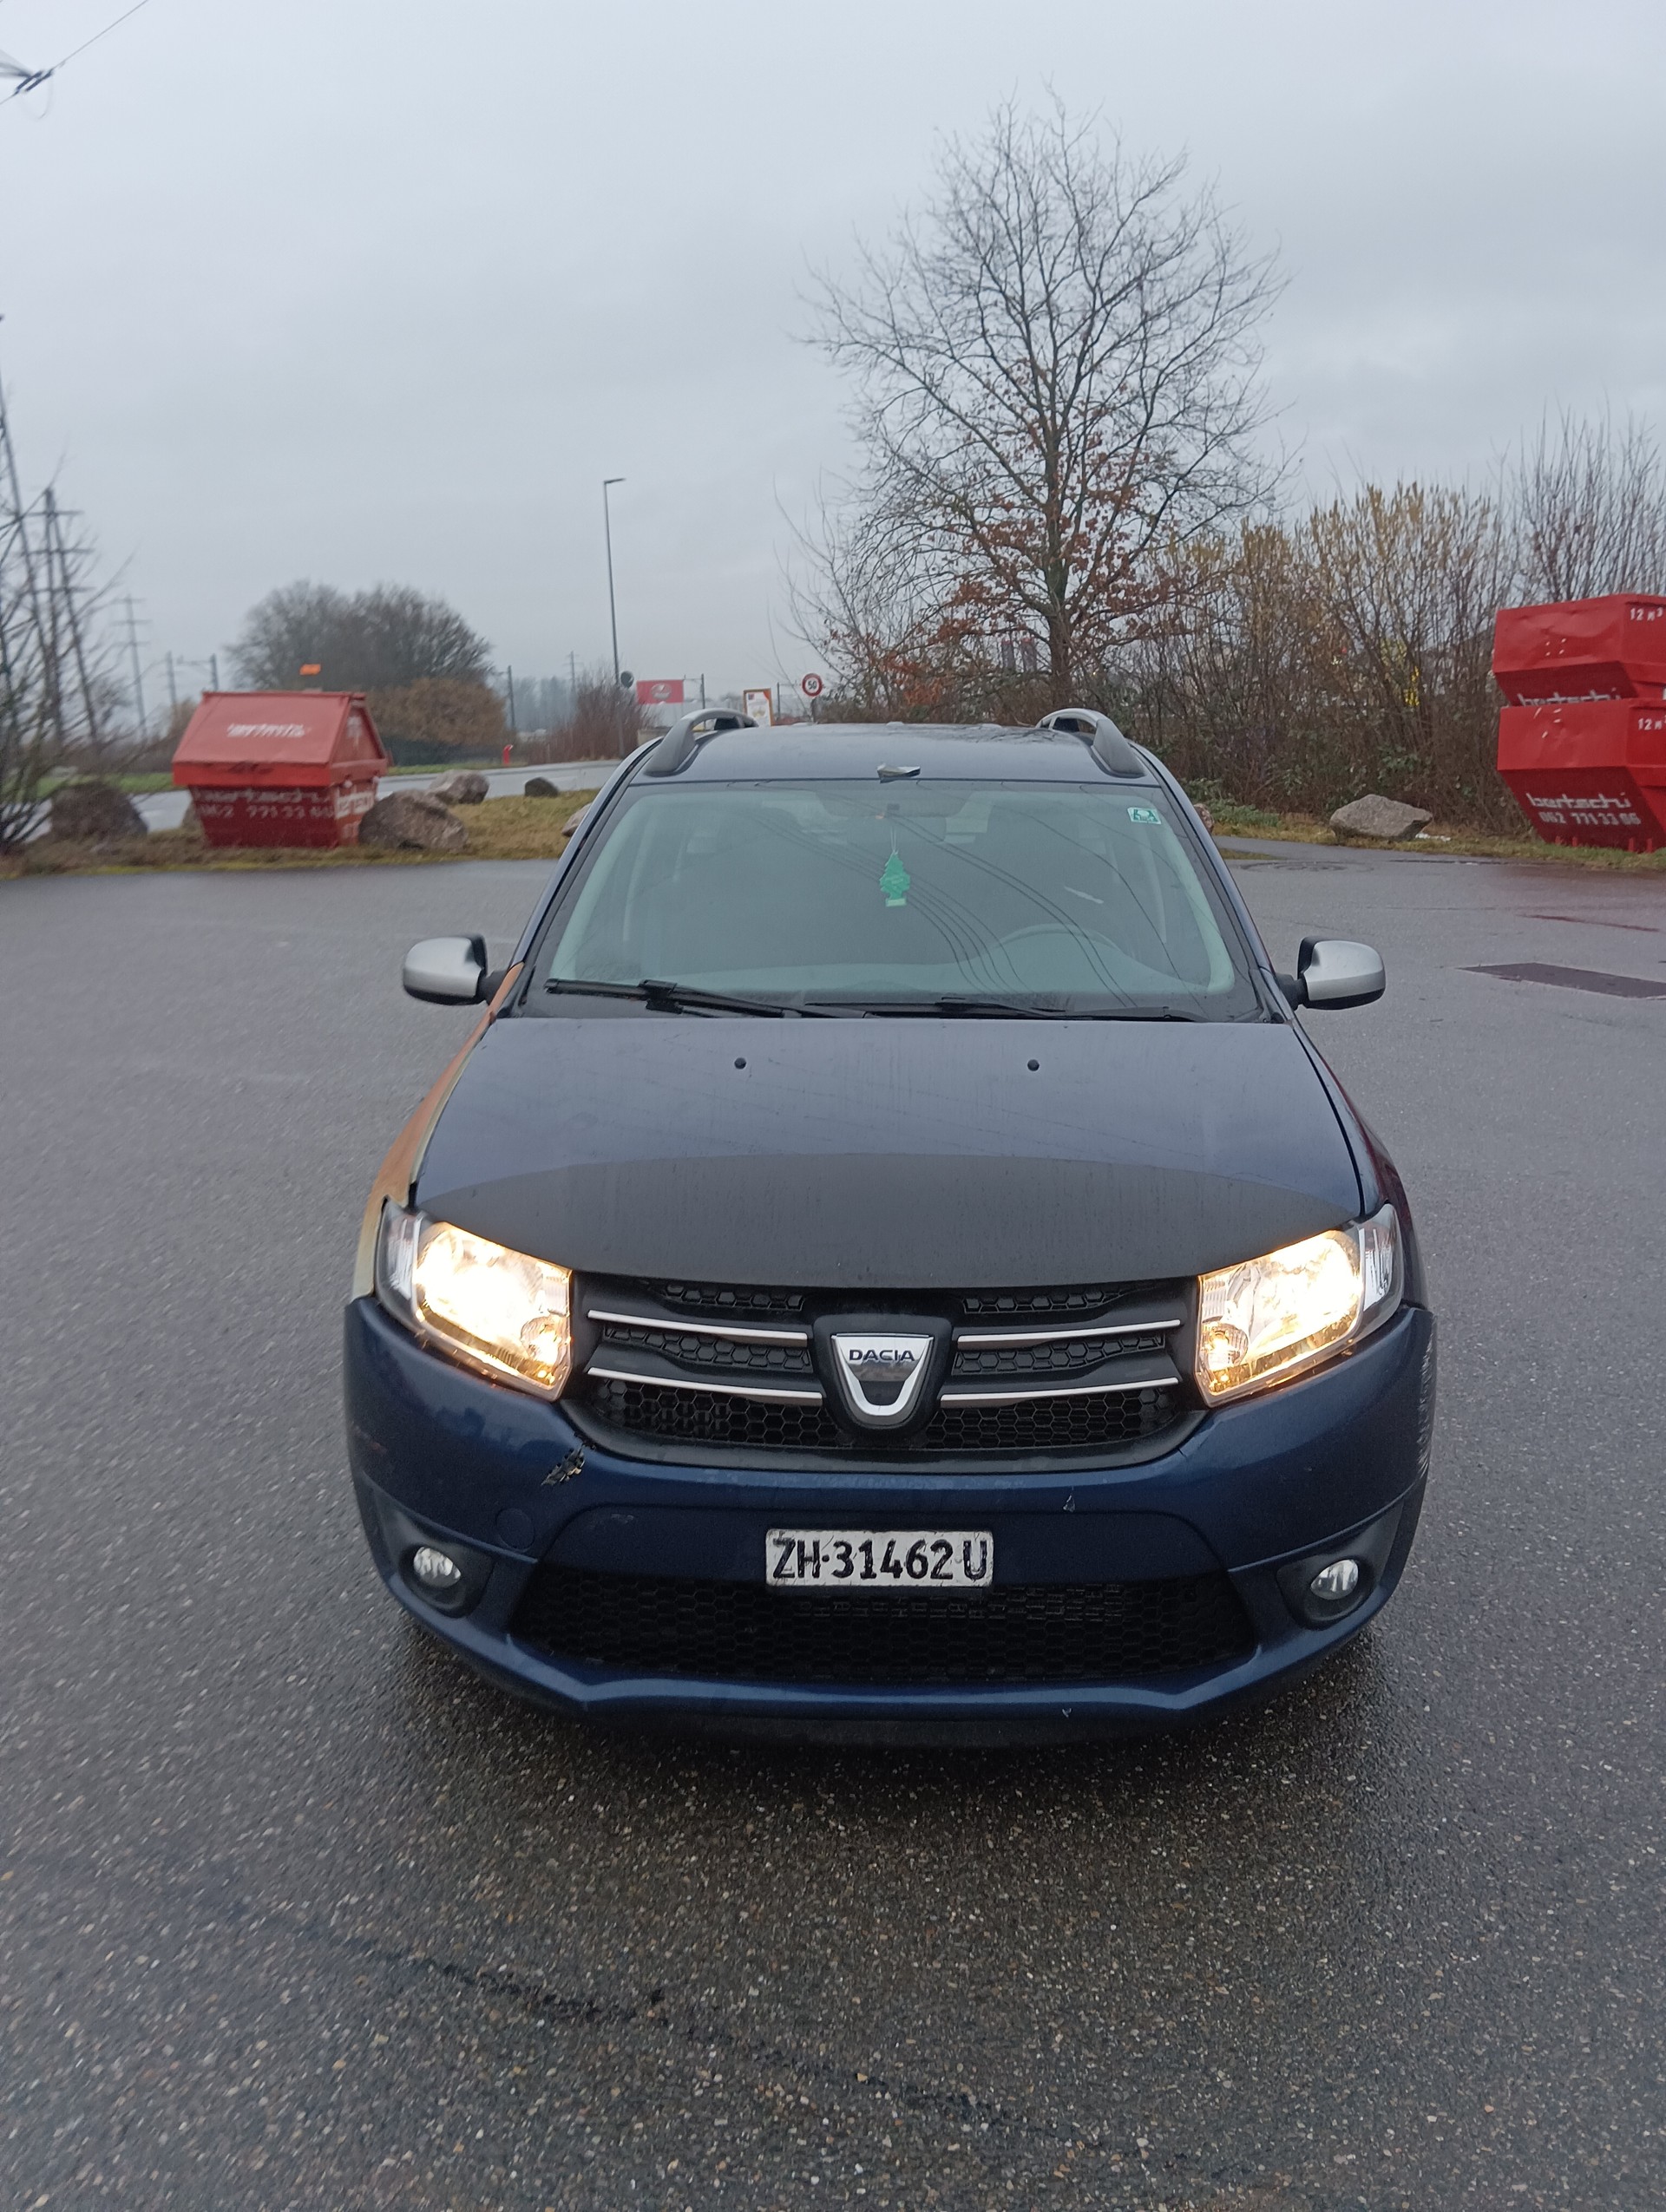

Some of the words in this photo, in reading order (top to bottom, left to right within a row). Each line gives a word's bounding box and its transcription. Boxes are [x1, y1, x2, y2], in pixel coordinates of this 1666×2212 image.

[1630, 607, 1644, 621] 12
[808, 680, 817, 690] 50
[1638, 717, 1652, 730] 12
[849, 1349, 915, 1362] DACIA
